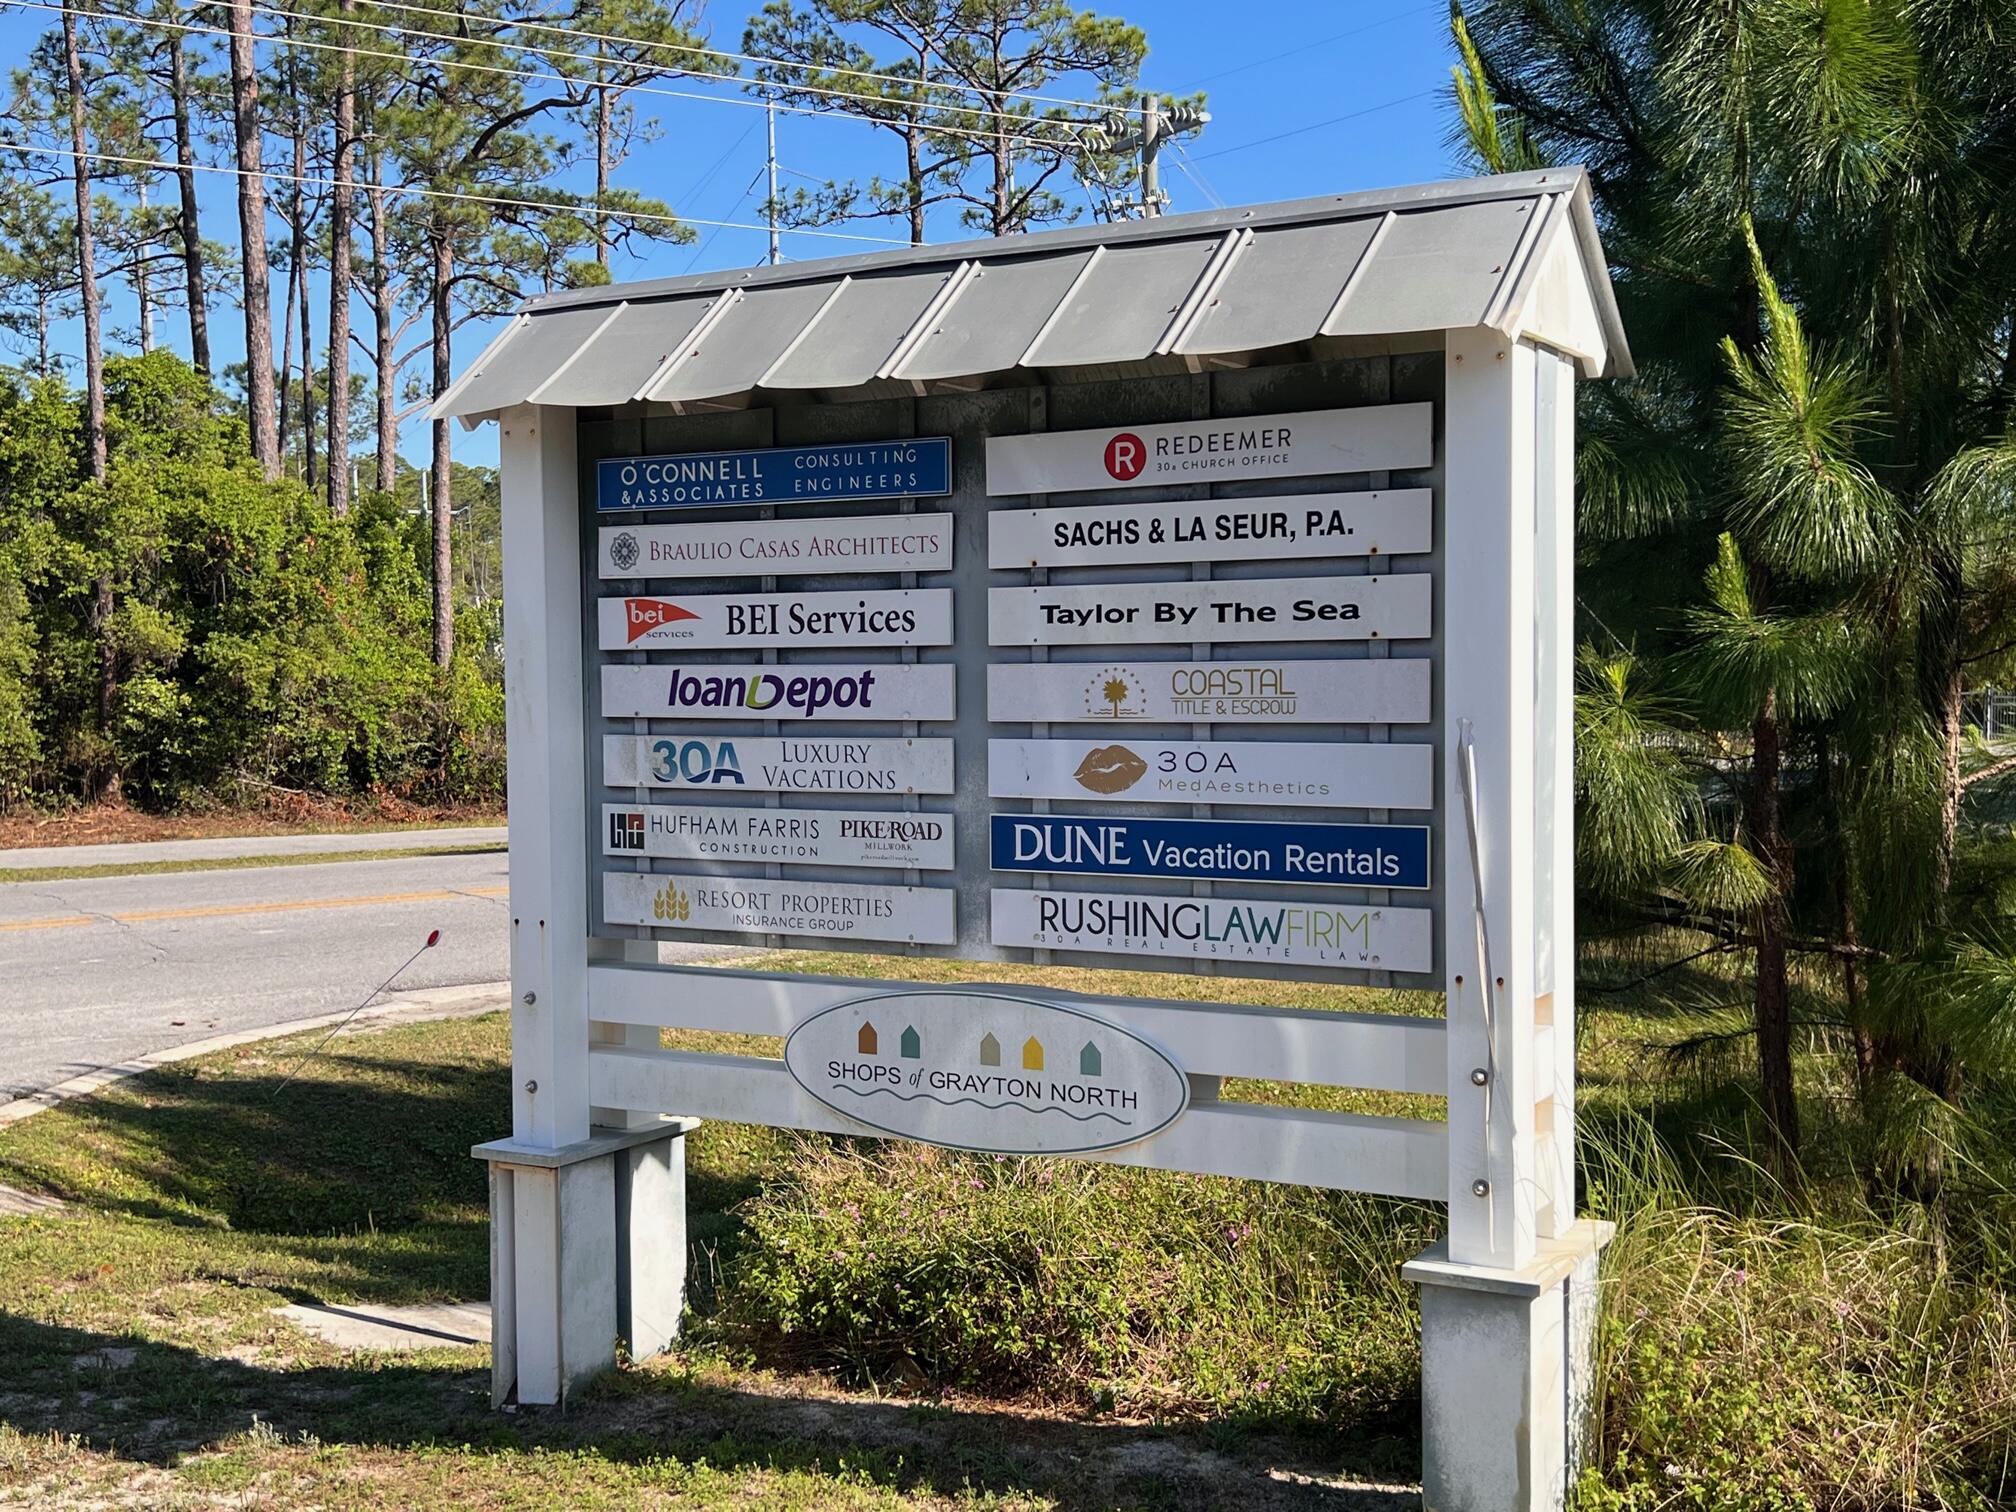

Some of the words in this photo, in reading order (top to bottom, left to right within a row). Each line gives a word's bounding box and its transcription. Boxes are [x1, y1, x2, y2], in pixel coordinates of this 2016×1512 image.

[1156, 428, 1292, 456] REDEEMER
[795, 449, 917, 470] CONSULTING
[1114, 441, 1135, 473] R
[1182, 456, 1235, 470] CHURCH
[1241, 453, 1289, 466] OFFICE
[620, 457, 763, 486] O'CONNELL
[795, 473, 917, 493] ENGINEERS
[621, 482, 764, 505] &ASSOCIATES
[1054, 518, 1140, 547] SACHS
[1148, 517, 1165, 543] &
[1174, 516, 1206, 542] LA
[1215, 512, 1296, 543] SEUR,
[1306, 510, 1354, 536] P.A.
[650, 541, 732, 561] BRAULIO
[739, 537, 800, 559] CASAS
[808, 534, 939, 557] ARCHITECTS
[629, 602, 665, 624] bei
[726, 603, 780, 635] BEI
[789, 600, 915, 634] Services
[1040, 604, 1140, 626] Taylor
[1154, 603, 1198, 626] By
[1211, 602, 1277, 622] The
[1292, 600, 1361, 620] Sea
[646, 630, 694, 638] services
[668, 669, 875, 717] loanDepot
[1172, 668, 1295, 695] COASTAL
[1172, 701, 1210, 714] TITLE
[1216, 701, 1227, 714] &
[1232, 700, 1296, 715] ESCROW
[782, 741, 872, 763] LUXURY
[762, 765, 896, 790] VACATIONS
[1158, 779, 1330, 796] MedAesthetics
[651, 816, 738, 836] HUFHAM
[748, 818, 820, 839] FARRIS
[699, 842, 819, 857] CONSTRUCTION
[865, 843, 912, 851] MILLWORK
[1013, 824, 1131, 866] DUNE
[1142, 839, 1270, 871] Vacation
[1285, 844, 1399, 877] Rentals
[698, 889, 771, 911] RESORT
[782, 894, 894, 917] PROPERTIES
[732, 914, 805, 929] INSURANCE
[809, 917, 854, 932] GROUP
[1108, 938, 1165, 950] REAL
[1192, 942, 1291, 958] ESTATE
[1321, 950, 1369, 962] LAW
[828, 1060, 901, 1085] SHOPS
[909, 1068, 924, 1088] of
[929, 1071, 1041, 1100] GRAYTON
[1050, 1083, 1137, 1109] NORTH
